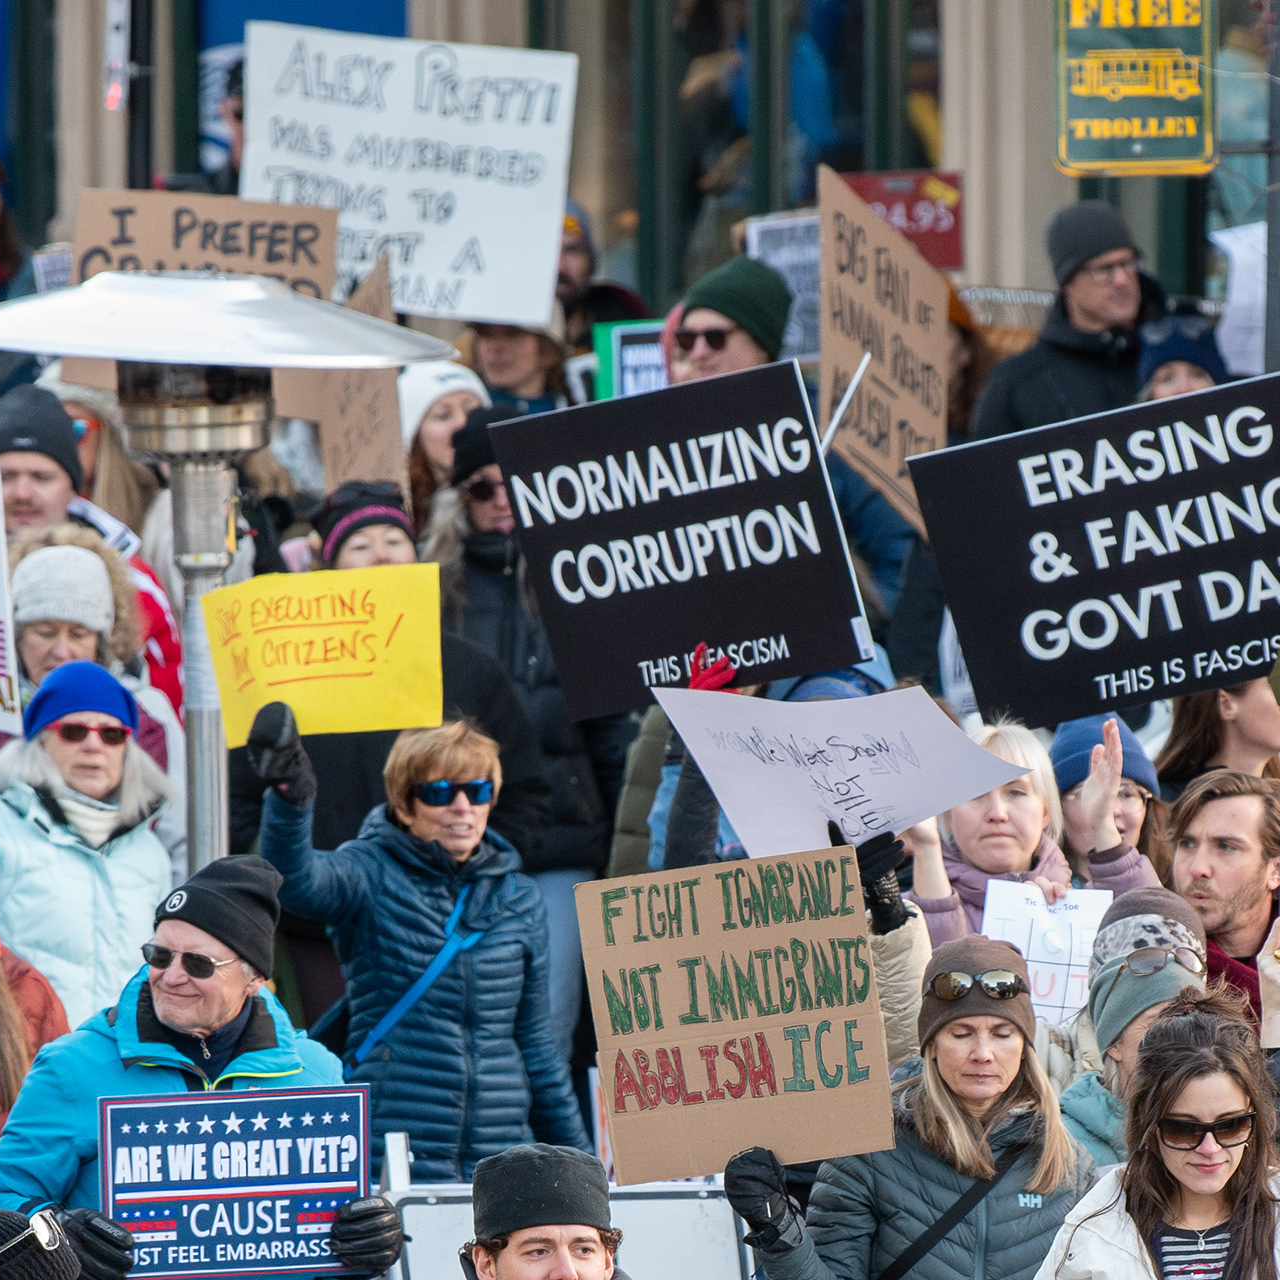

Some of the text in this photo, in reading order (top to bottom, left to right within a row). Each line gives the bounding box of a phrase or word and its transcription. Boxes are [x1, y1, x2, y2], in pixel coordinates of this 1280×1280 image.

[1069, 0, 1202, 28] FREE
[275, 37, 562, 126] ALEX PRETTI
[1069, 116, 1200, 140] TROLLEY
[344, 133, 548, 189] MURDERED
[408, 188, 457, 225] TO
[111, 207, 320, 265] I PREFER
[451, 235, 486, 275] A
[833, 211, 868, 284] BIG
[874, 247, 910, 325] FAN
[829, 280, 885, 366] HUMAN
[891, 334, 942, 417] RIGHTS
[511, 416, 811, 529] NORMALIZING
[1019, 406, 1273, 507] ERASING
[550, 502, 820, 604] CORRUPTION
[1029, 532, 1078, 584] &
[250, 589, 376, 627] EXECUTING
[1021, 580, 1182, 663] GOVT
[637, 656, 681, 686] THIS
[1095, 664, 1154, 701] THIS
[1162, 657, 1187, 692] IS
[810, 775, 865, 796] NOT
[601, 856, 855, 947] FIGHT IGNORANCE
[604, 936, 871, 1036] NOT IMMIGRANTS
[613, 1020, 871, 1114] ABOLISH ICE
[114, 1133, 358, 1184] ARE WE GREAT YET?
[182, 1199, 291, 1238] 'CAUSE
[1018, 1193, 1042, 1208] HH
[125, 1238, 338, 1266] UST FEEL EMBARRASS
